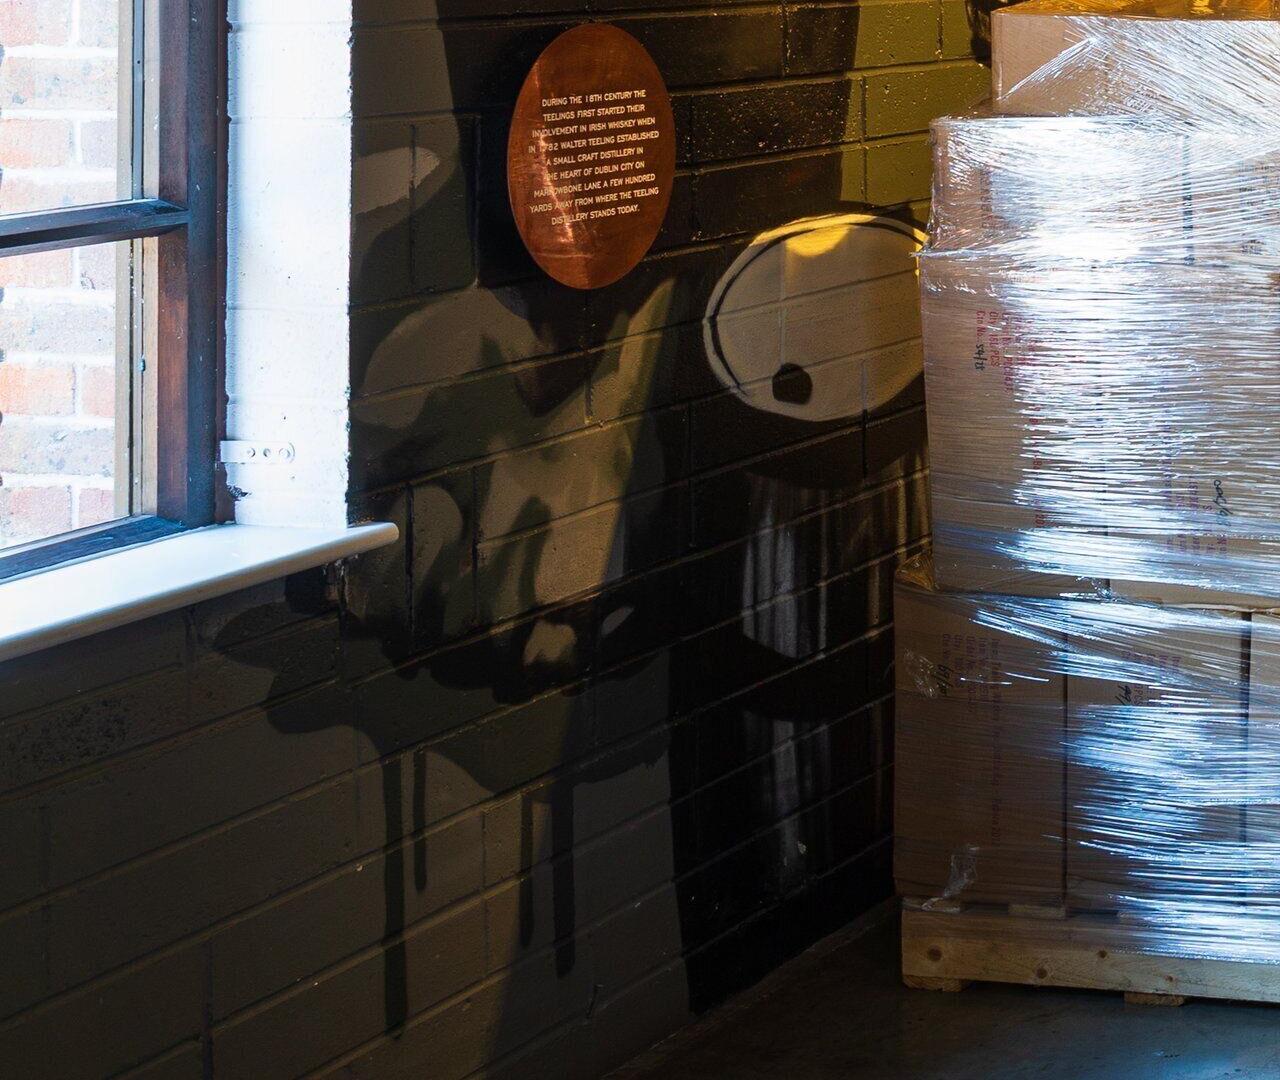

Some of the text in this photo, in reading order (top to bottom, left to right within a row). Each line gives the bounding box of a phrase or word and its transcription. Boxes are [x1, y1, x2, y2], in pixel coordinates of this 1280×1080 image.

[542, 89, 646, 107] DURING THE 18TH CENTURY THE
[543, 103, 645, 122] TEELINGS FIRST STARTED THEIR
[532, 117, 656, 139] INVOLVEMENT IN IRISH WHISKEY WHEN
[545, 158, 552, 166] A
[553, 156, 576, 166] SMALL
[577, 152, 599, 162] CRAFT
[600, 147, 636, 160] DISTILLERY
